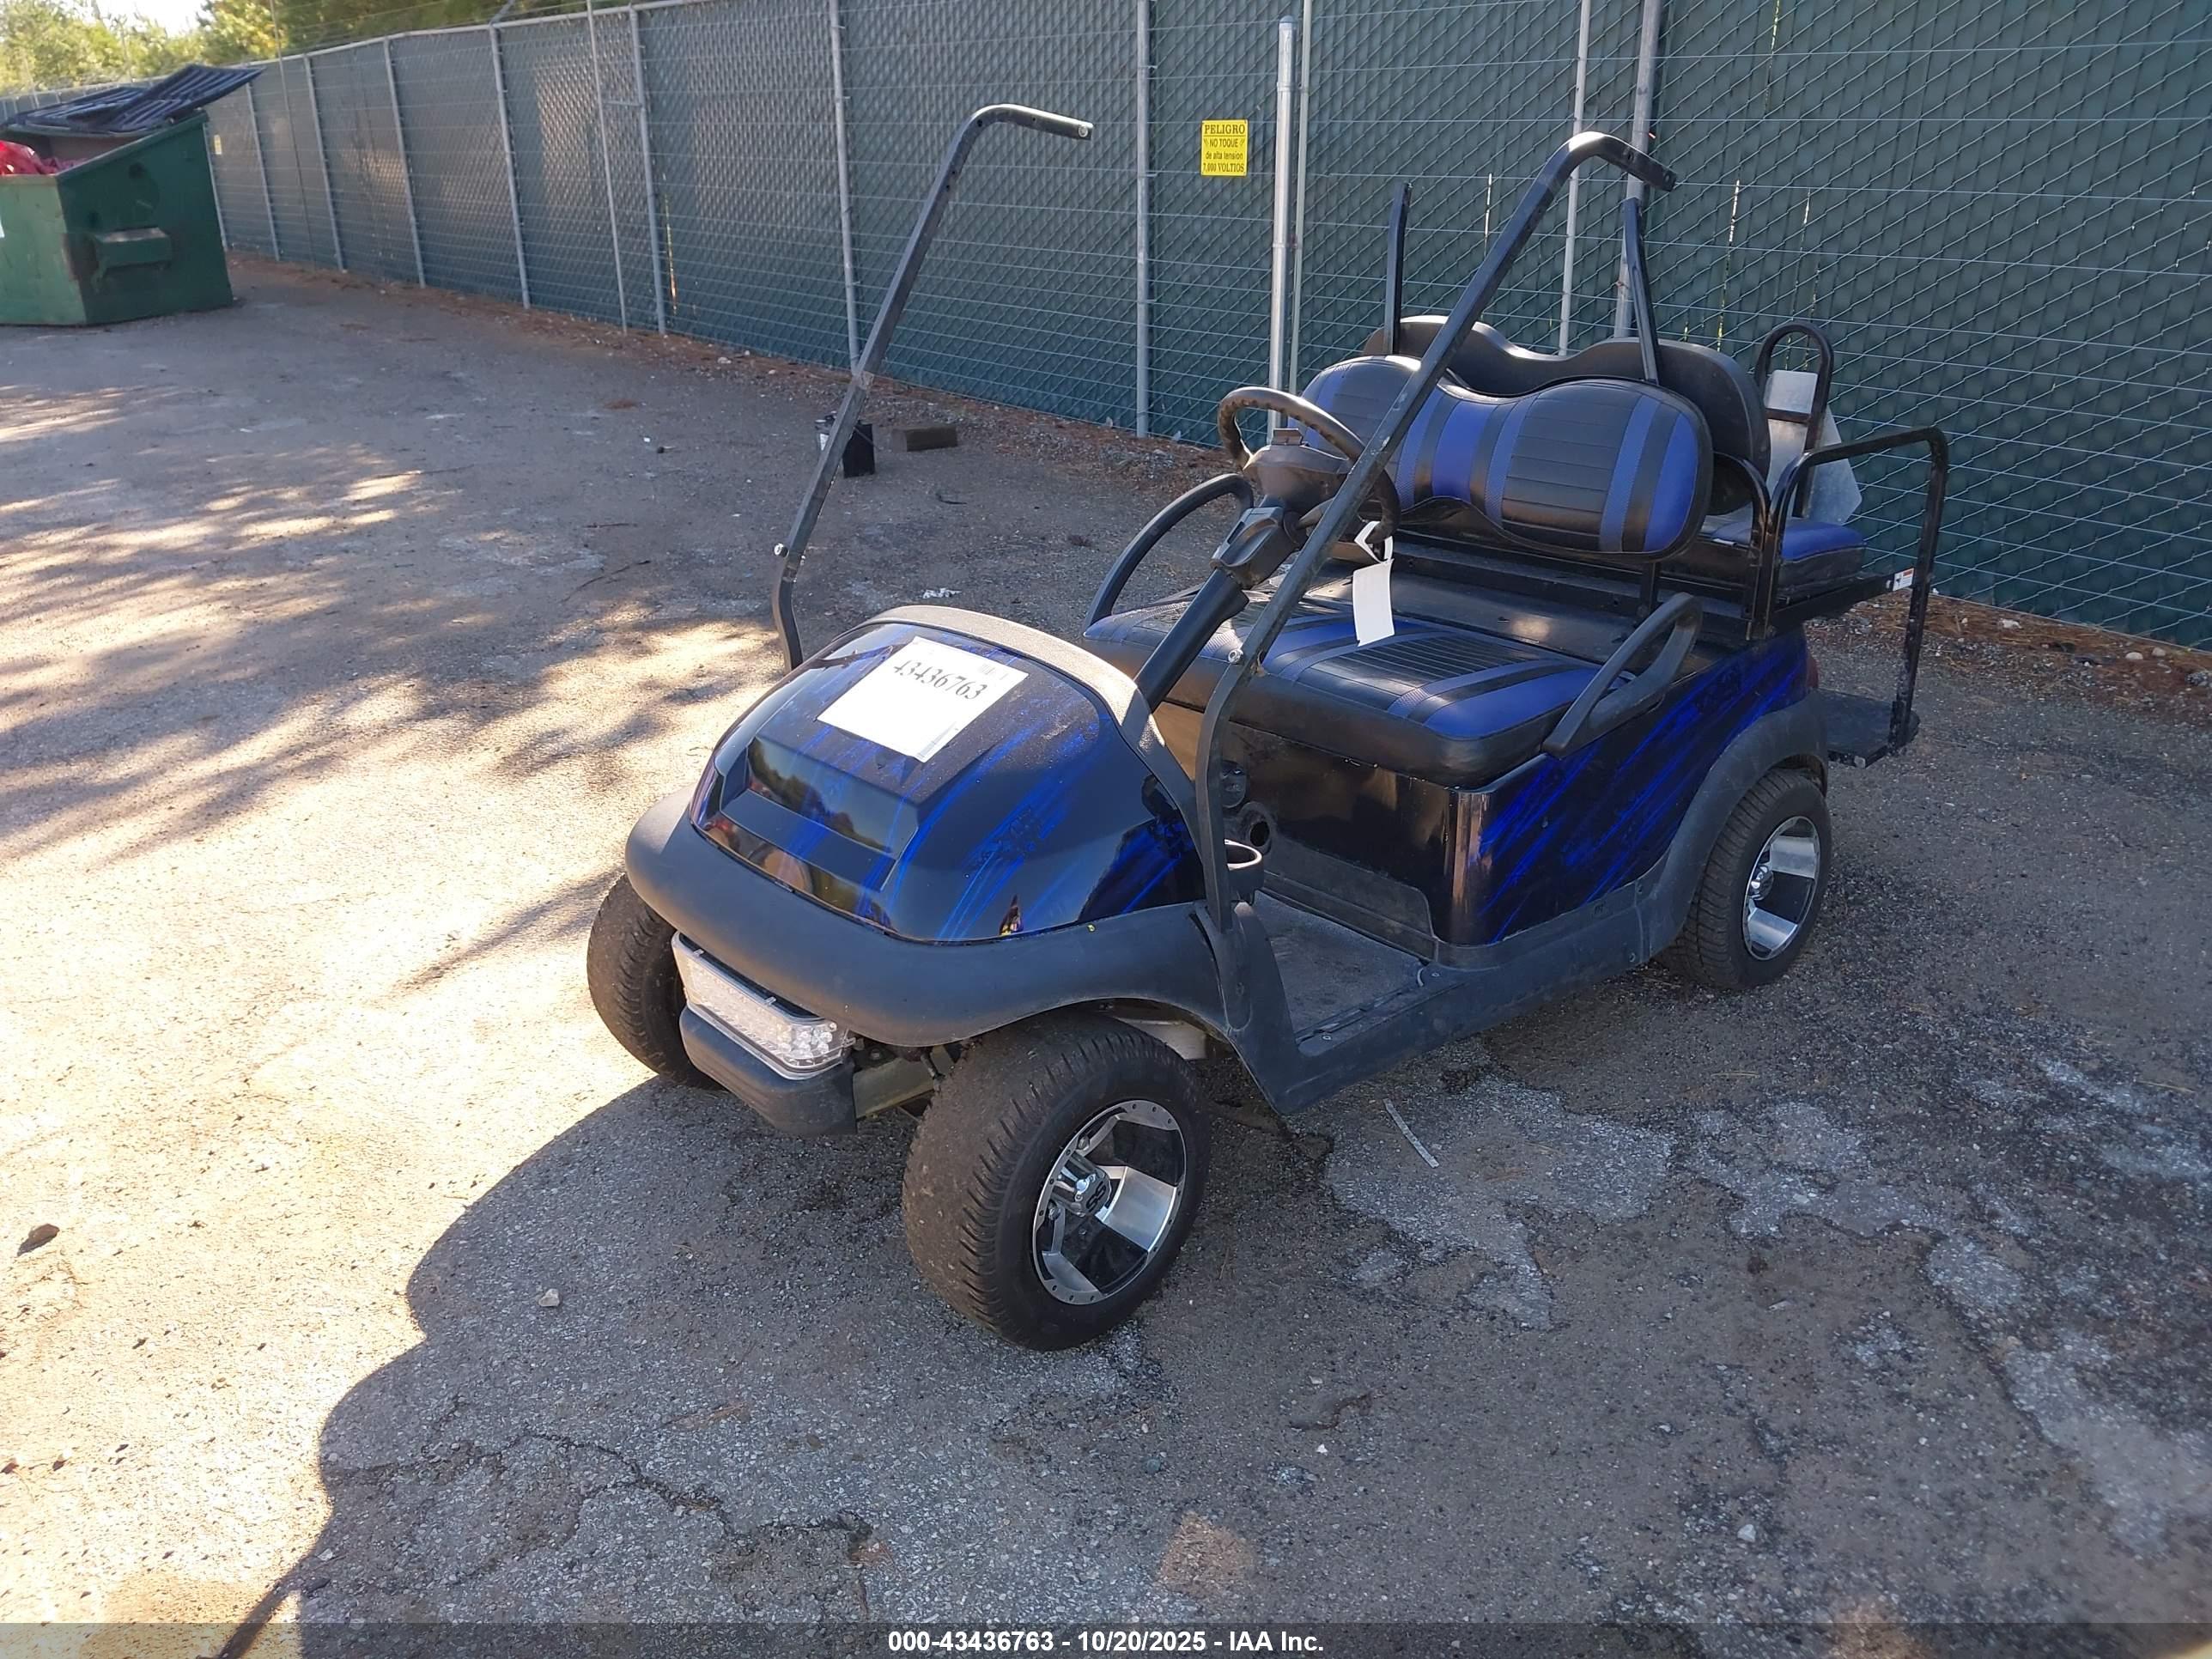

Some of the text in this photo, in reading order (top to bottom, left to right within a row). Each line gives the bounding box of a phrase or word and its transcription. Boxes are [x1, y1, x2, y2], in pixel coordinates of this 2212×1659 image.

[1204, 125, 1245, 134] PELIGRO
[1209, 138, 1238, 148] NO TOQUE
[1205, 151, 1212, 160] de
[1213, 151, 1223, 160] alta
[1218, 162, 1244, 173] VOLTIOS
[893, 659, 988, 700] 43436763
